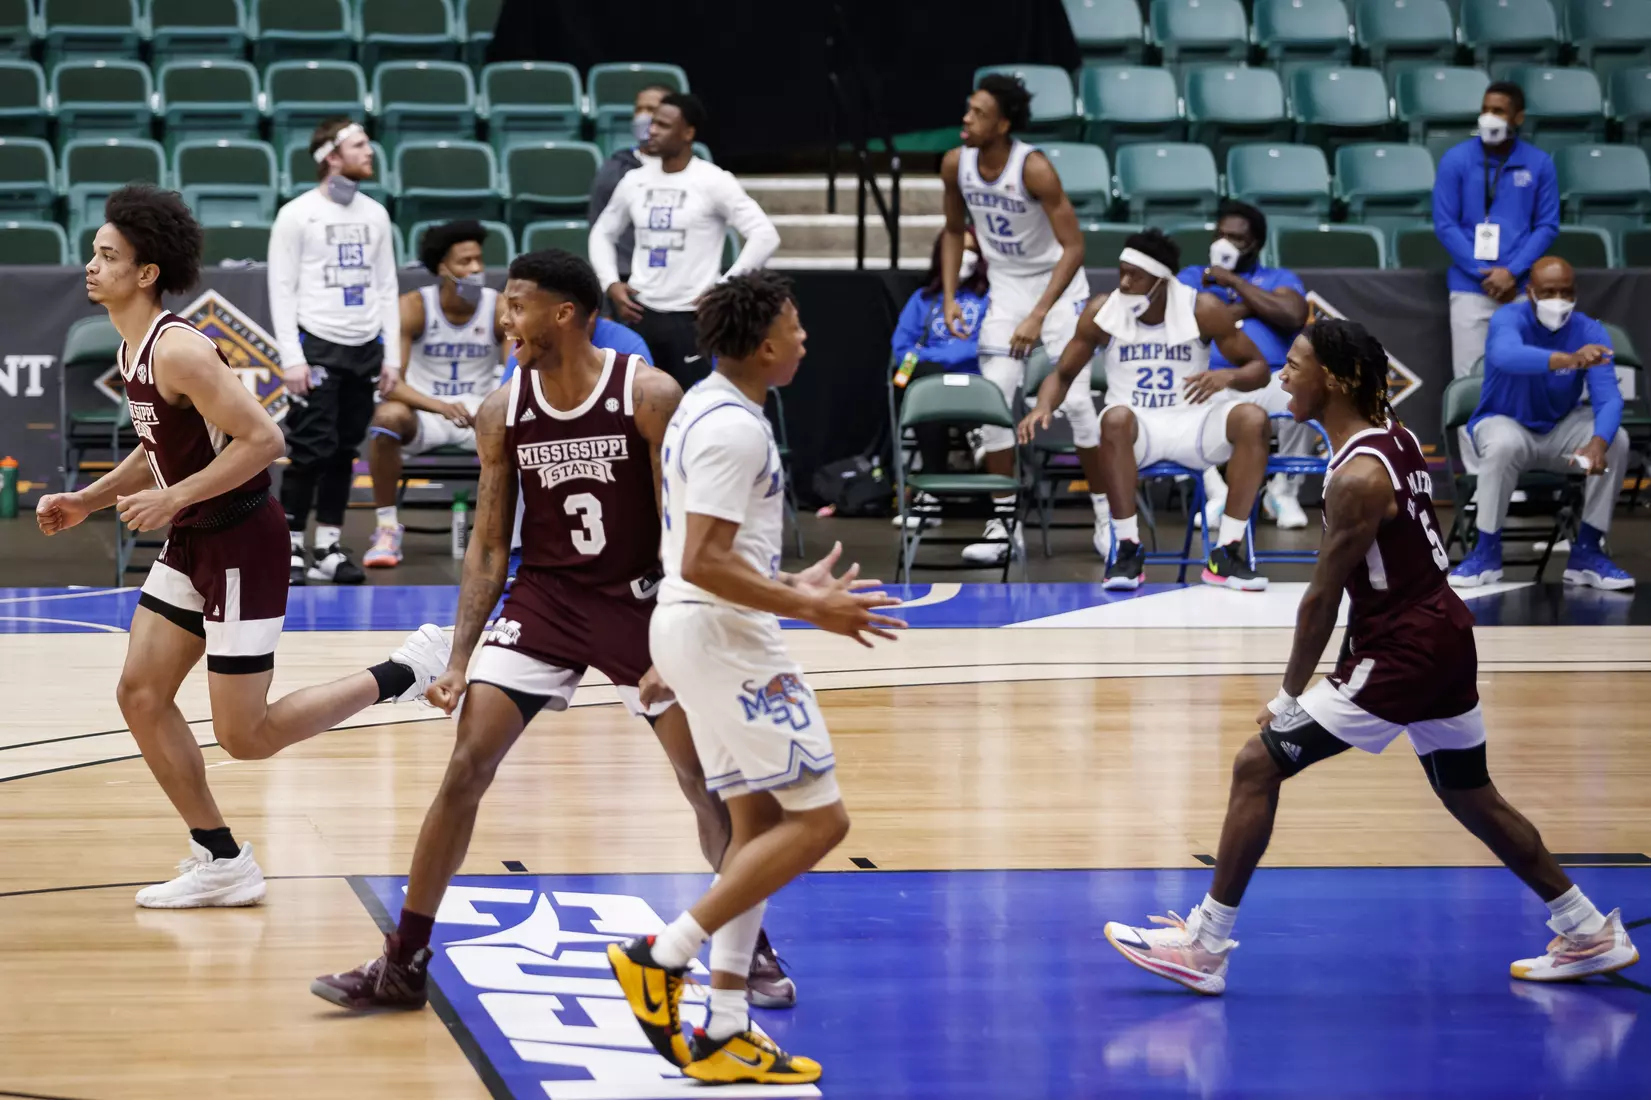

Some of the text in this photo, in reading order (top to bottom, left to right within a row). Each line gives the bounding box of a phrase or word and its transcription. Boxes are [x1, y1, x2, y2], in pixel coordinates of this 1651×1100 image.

[986, 213, 1013, 237] 12
[1119, 343, 1192, 362] MEMPHIS
[450, 361, 459, 380] 1
[1136, 366, 1174, 390] 23
[1131, 390, 1177, 408] STATE
[517, 438, 628, 466] MISSISSIPPI
[551, 462, 600, 482] STATE
[563, 486, 607, 556] 3
[1419, 508, 1449, 572] 5
[736, 686, 811, 732] MSU
